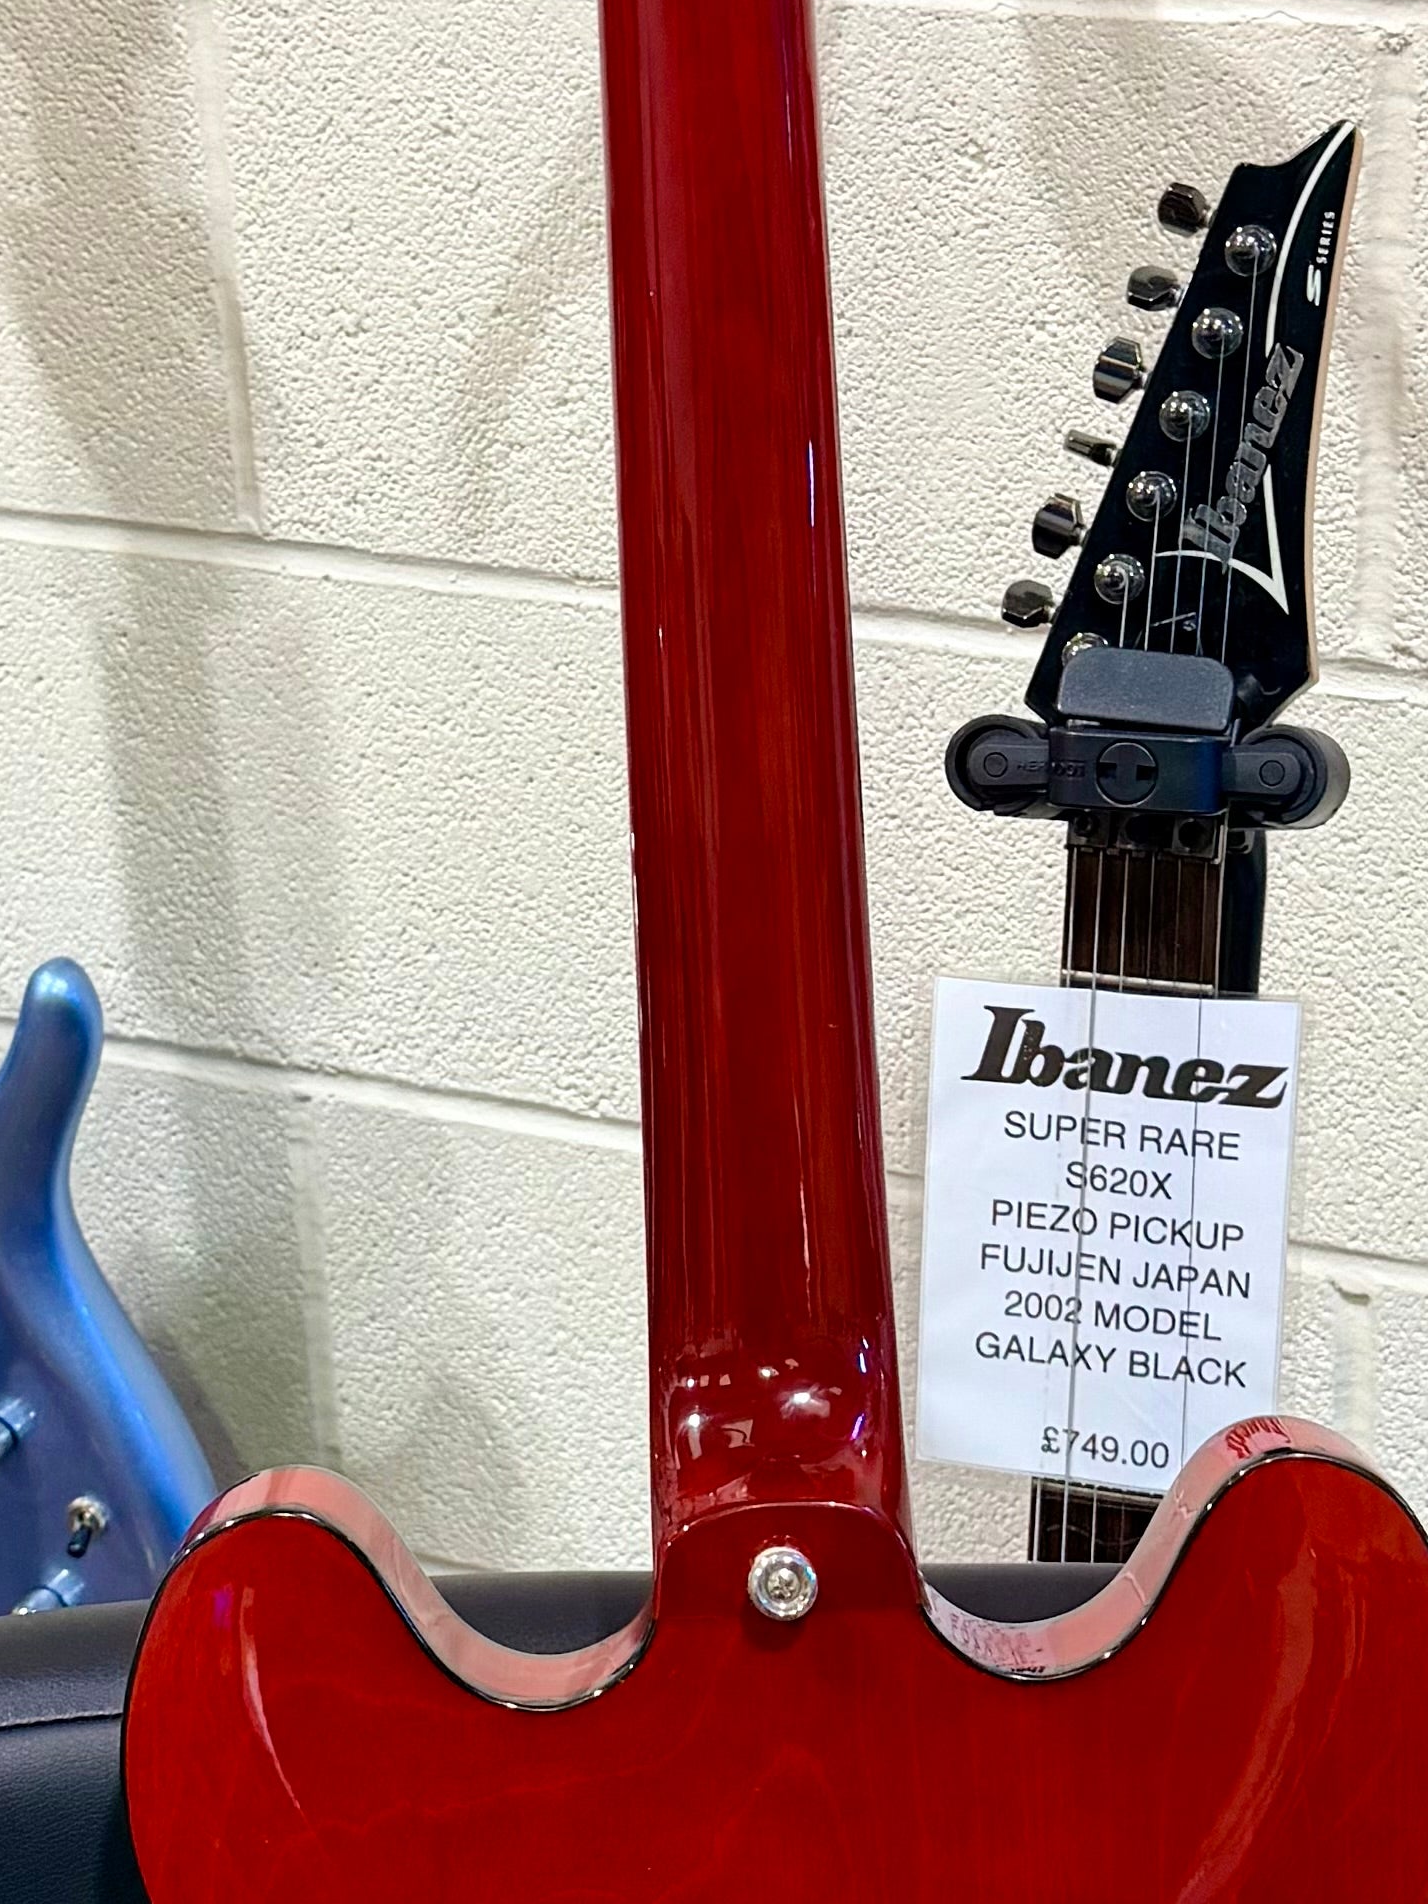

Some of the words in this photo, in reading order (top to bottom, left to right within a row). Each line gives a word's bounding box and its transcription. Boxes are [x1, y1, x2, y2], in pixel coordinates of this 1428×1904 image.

[1316, 211, 1336, 264] SERIES
[1183, 343, 1304, 574] Ibanez
[961, 1004, 1289, 1109] Ibanez
[1004, 1110, 1126, 1150] SUPER
[1139, 1124, 1241, 1161] RARE
[1066, 1161, 1172, 1200] S620X
[991, 1200, 1097, 1236] PIEZO
[1110, 1213, 1244, 1253] PICKUP
[980, 1242, 1121, 1286] FUJIJEN
[1134, 1260, 1252, 1299] JAPAN
[1004, 1290, 1083, 1325] 2002
[1093, 1301, 1222, 1342] MODEL
[975, 1332, 1117, 1373] GALAXY
[1129, 1353, 1247, 1389] BLACK
[1041, 1426, 1170, 1469] £749.00
